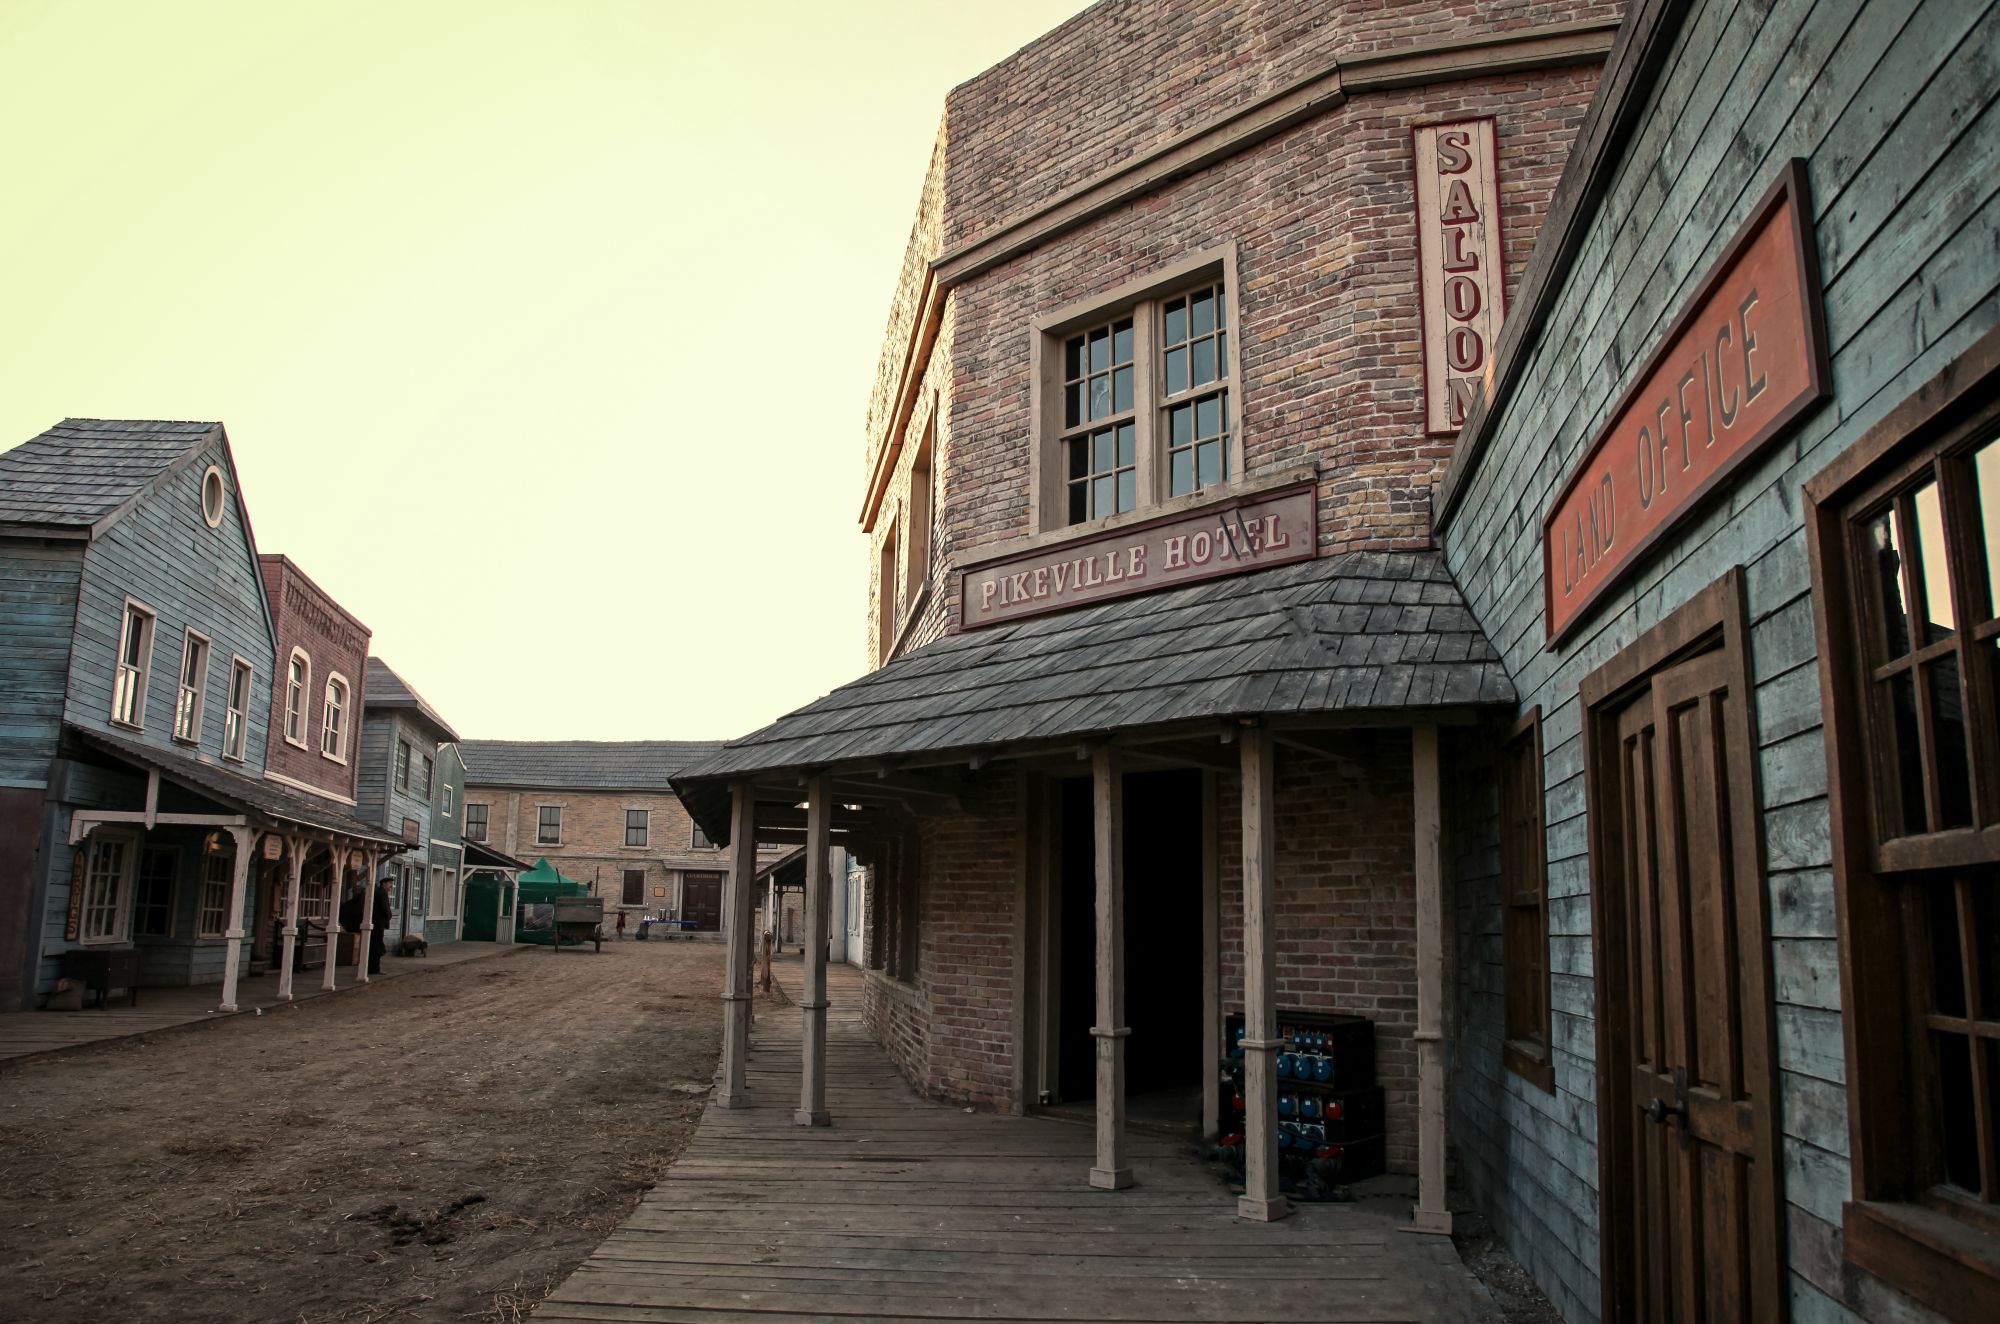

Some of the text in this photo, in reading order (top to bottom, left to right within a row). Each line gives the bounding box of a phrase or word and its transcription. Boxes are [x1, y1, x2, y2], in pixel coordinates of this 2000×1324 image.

[1436, 131, 1484, 426] SALOON
[980, 513, 1288, 613] PIKEVILLE HOTEL
[1562, 288, 1768, 598] LAND OFFICE
